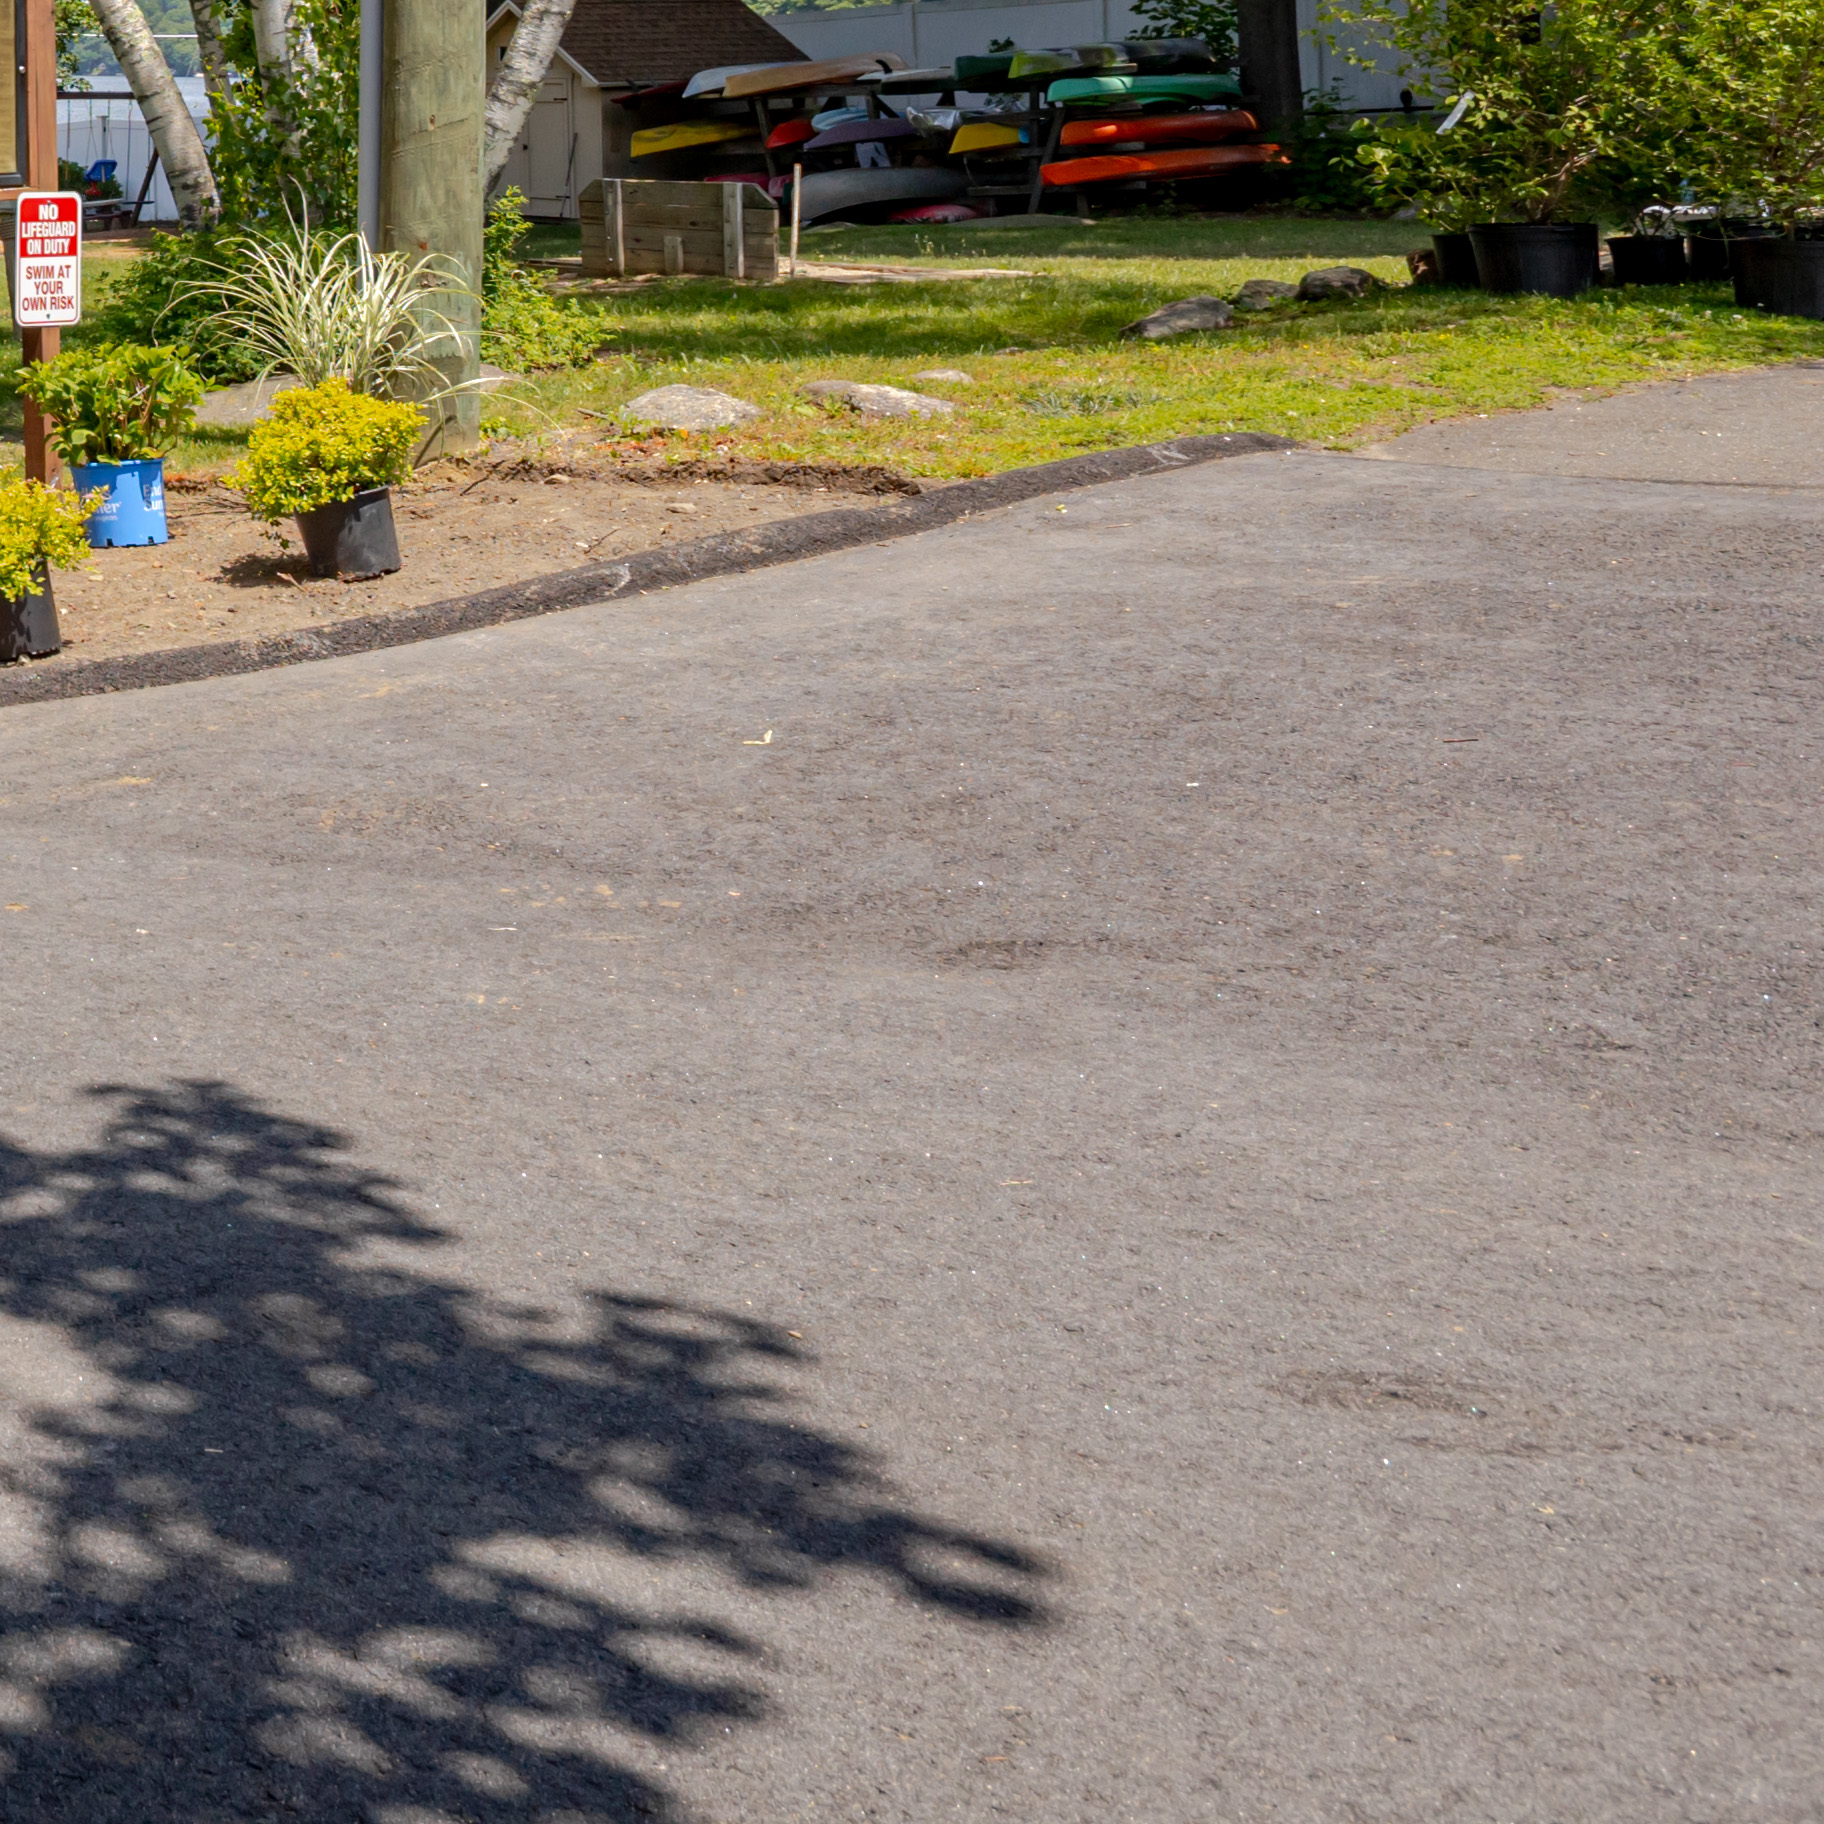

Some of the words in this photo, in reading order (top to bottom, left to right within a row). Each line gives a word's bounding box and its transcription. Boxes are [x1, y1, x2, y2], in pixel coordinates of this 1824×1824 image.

[39, 204, 58, 220] NO
[22, 221, 76, 238] LIFEGUARD
[27, 239, 41, 255] ON
[44, 238, 70, 254] DUTY
[26, 266, 54, 279] SWIM
[58, 265, 71, 278] AT
[34, 281, 63, 294] YOUR
[22, 297, 46, 310] OWN
[50, 296, 74, 309] RISK
